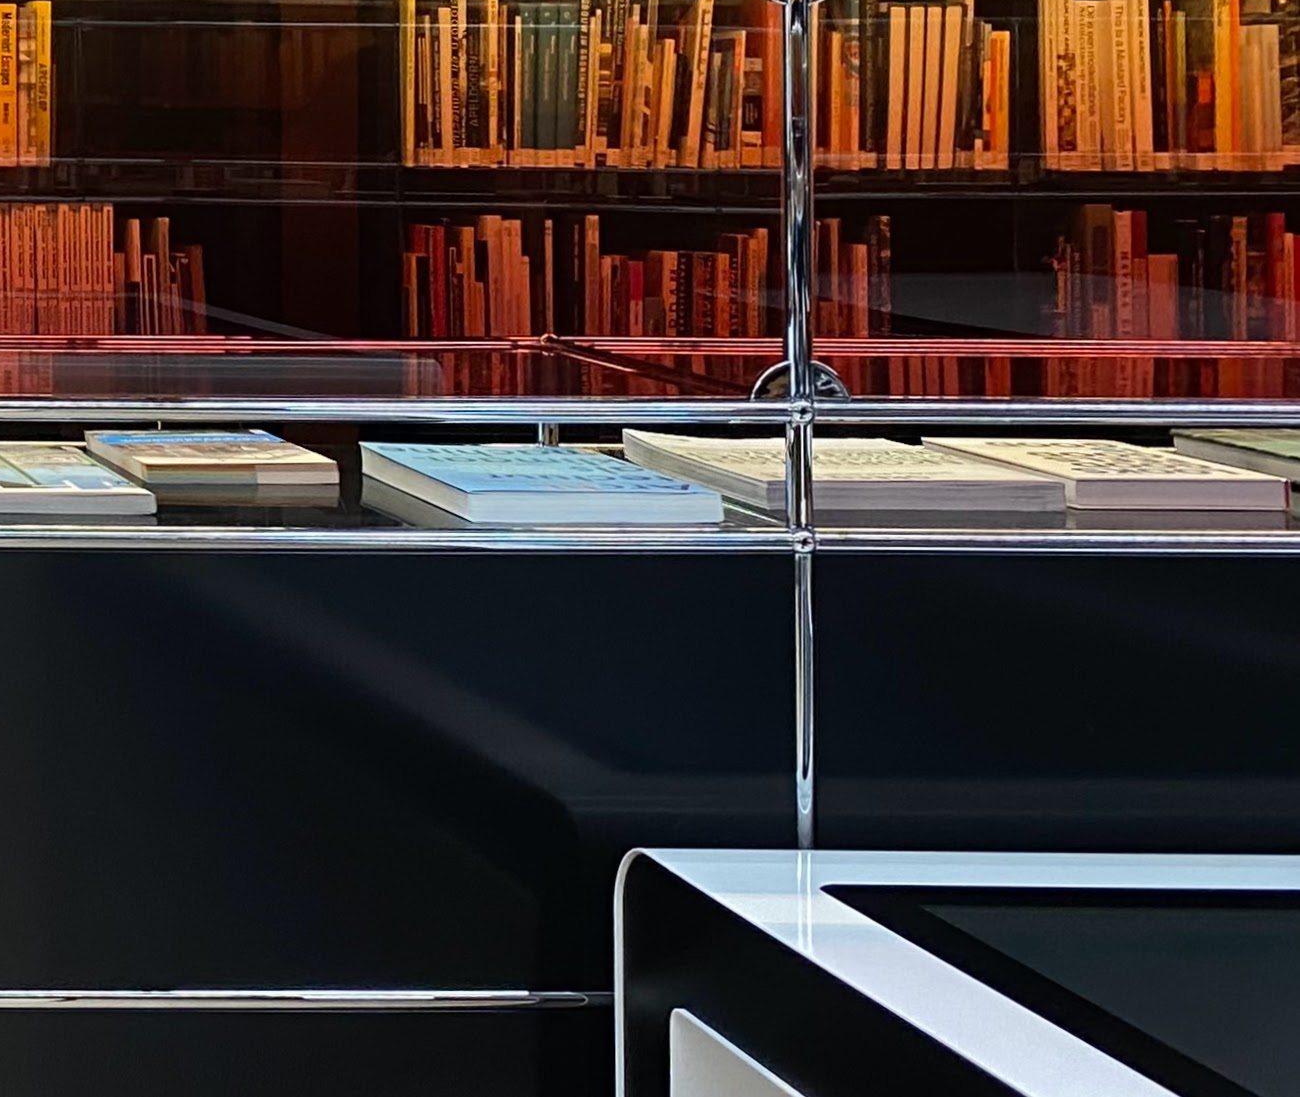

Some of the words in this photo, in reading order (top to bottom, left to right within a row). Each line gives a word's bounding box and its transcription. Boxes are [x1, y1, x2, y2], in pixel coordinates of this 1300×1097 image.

[1, 12, 14, 53] Modernist
[1115, 5, 1124, 27] This
[1116, 28, 1124, 38] is
[1, 55, 14, 87] Escapes
[1117, 48, 1127, 88] Mustard
[39, 62, 48, 112] ARCHIFLOP
[1118, 90, 1127, 125] Factory
